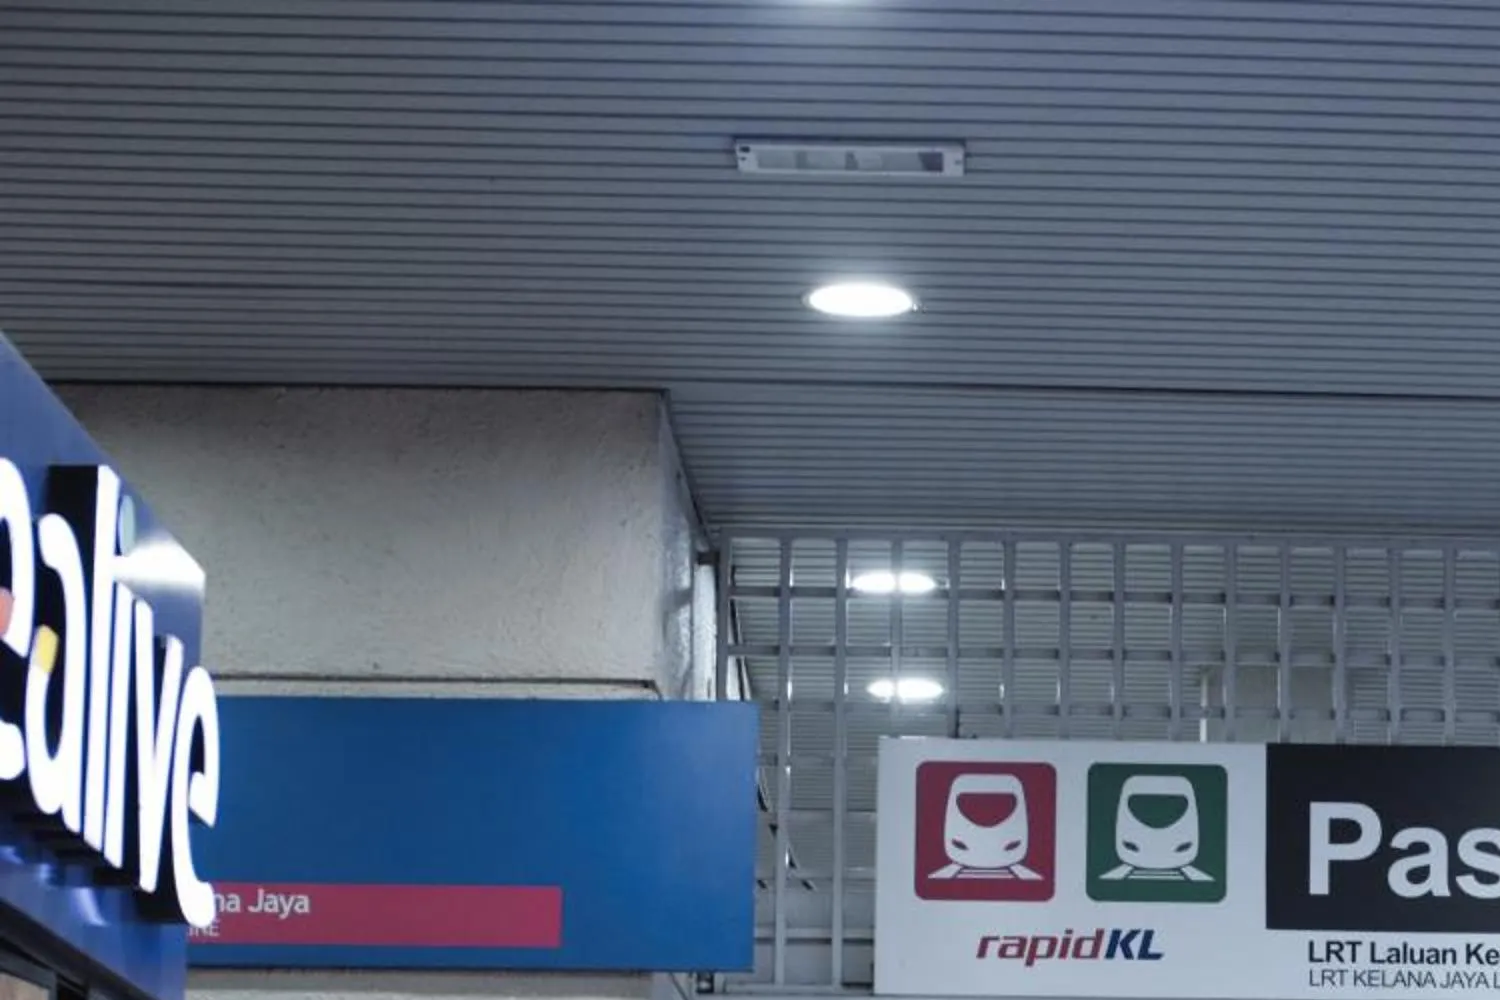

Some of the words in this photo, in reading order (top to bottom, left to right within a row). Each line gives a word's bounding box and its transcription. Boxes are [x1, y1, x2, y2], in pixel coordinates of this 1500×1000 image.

[248, 888, 310, 920] Jaya
[975, 928, 1165, 967] rapidKL
[1308, 940, 1363, 964] LRT
[1369, 941, 1457, 966] Laluan
[1308, 968, 1349, 988] LRT
[1353, 970, 1437, 989] KELANA
[1439, 971, 1490, 990] JAYA
